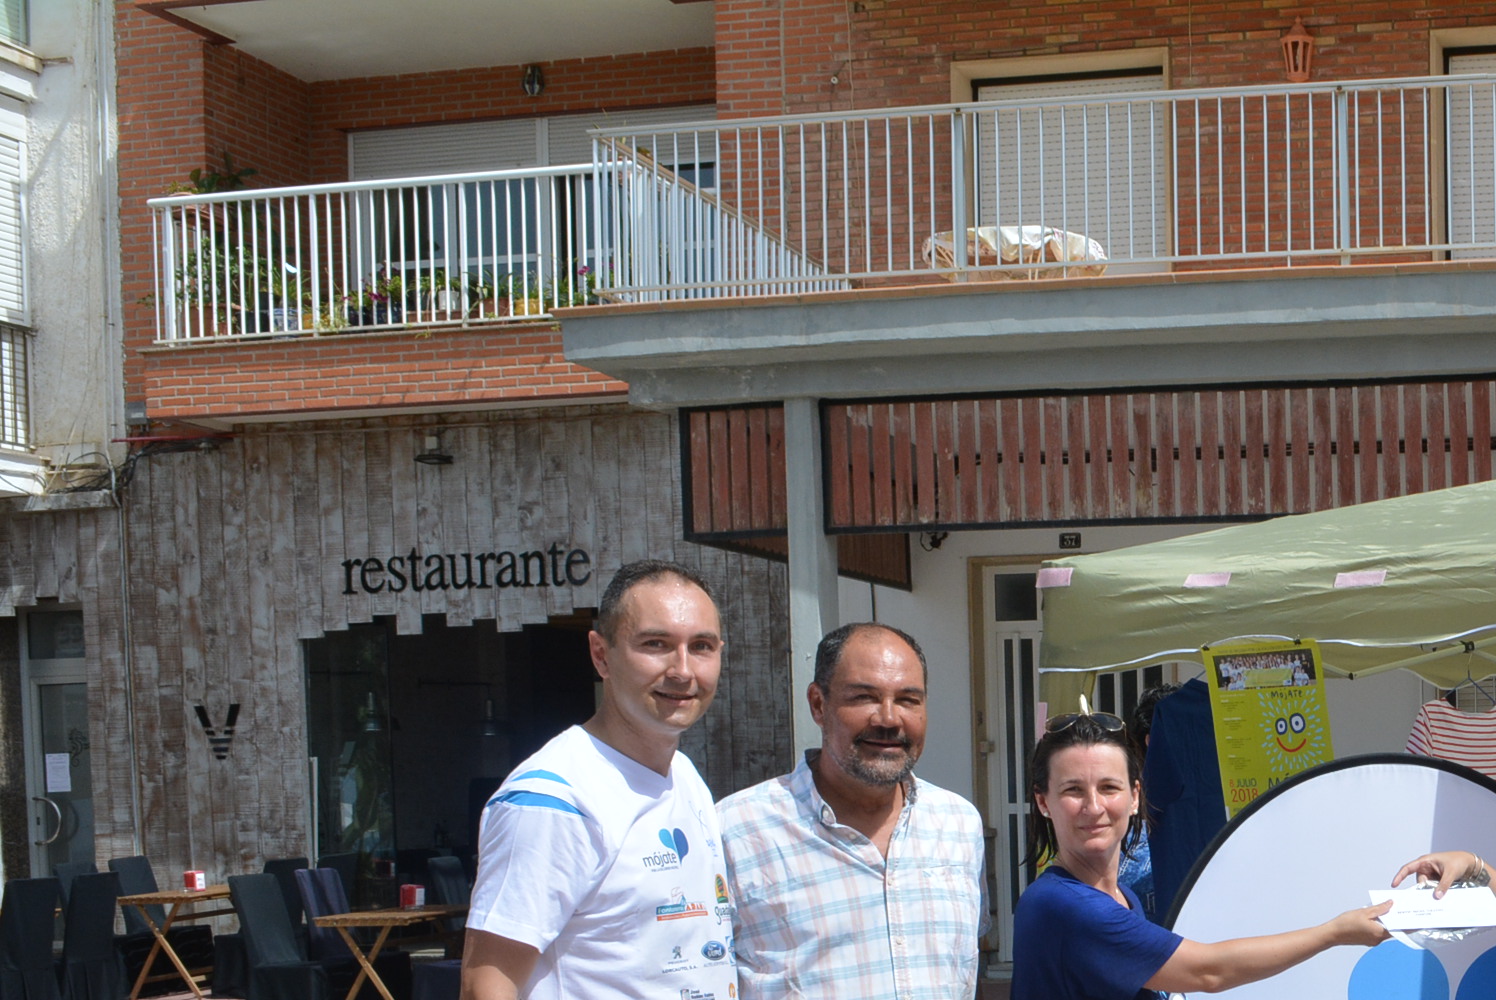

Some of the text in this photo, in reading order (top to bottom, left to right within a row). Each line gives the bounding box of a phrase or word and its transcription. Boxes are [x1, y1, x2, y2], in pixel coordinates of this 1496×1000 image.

[341, 541, 592, 595] restaurante
[1236, 777, 1258, 788] JULIO
[1230, 788, 1259, 803] 2018
